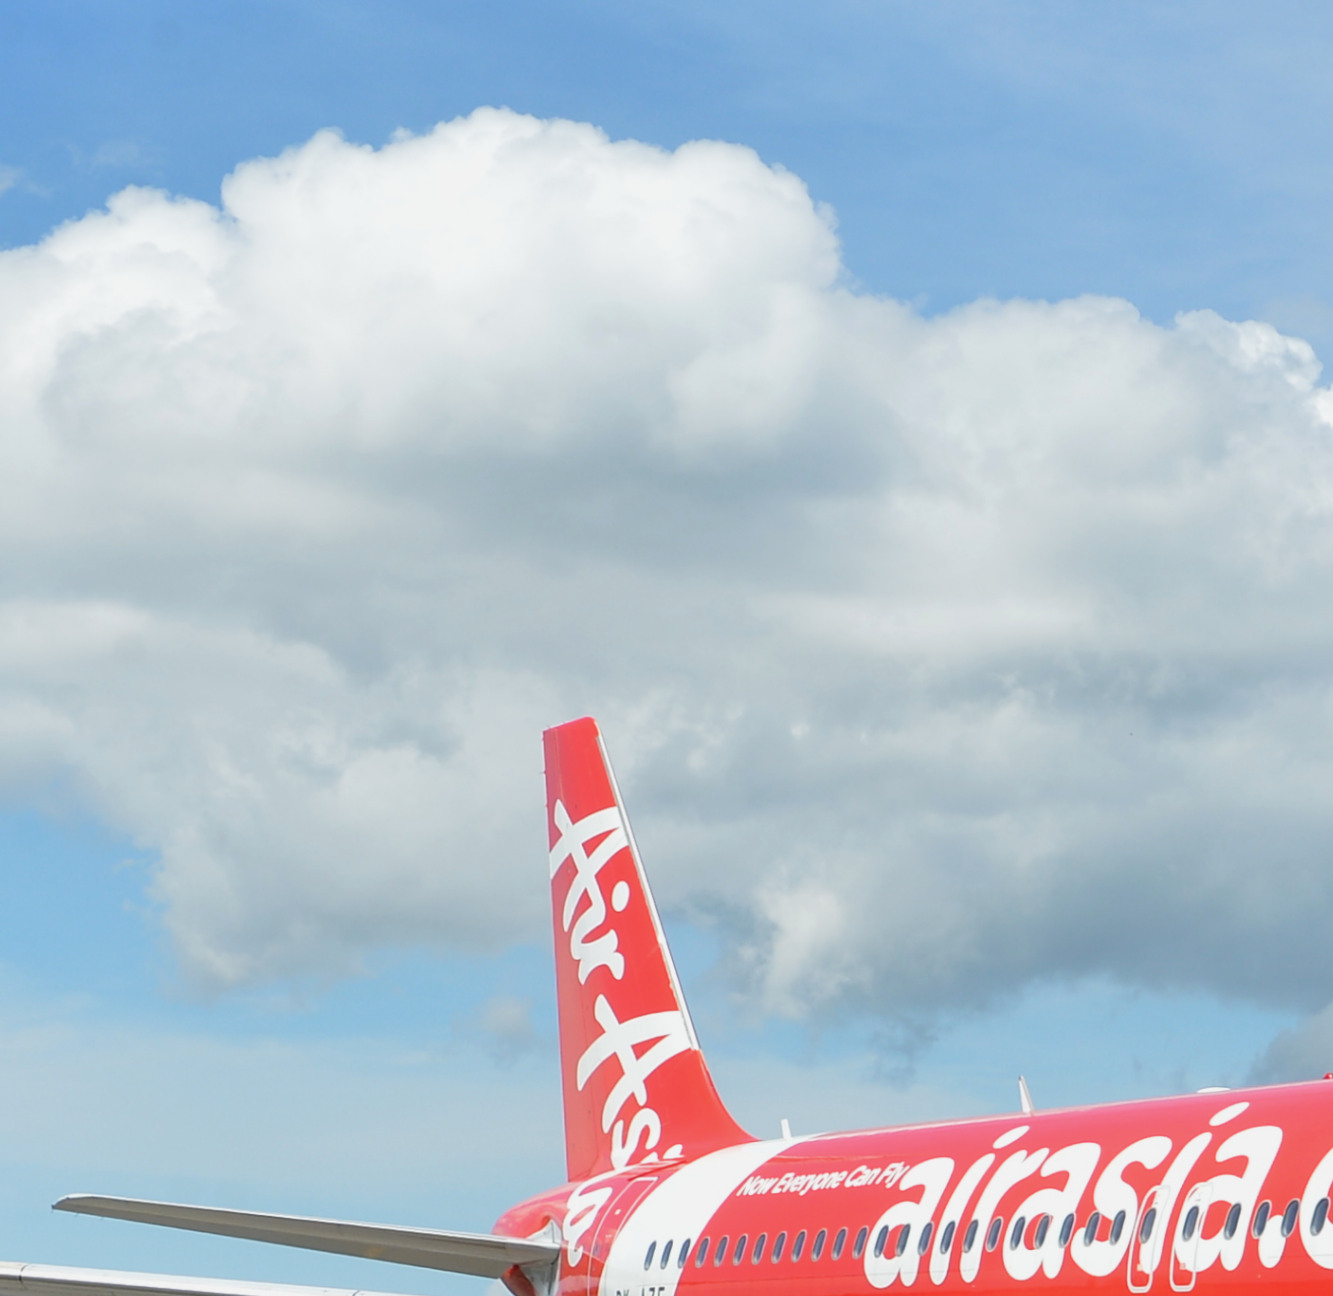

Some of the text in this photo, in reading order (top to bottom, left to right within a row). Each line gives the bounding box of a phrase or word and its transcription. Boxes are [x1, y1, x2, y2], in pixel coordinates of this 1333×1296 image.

[550, 798, 629, 985] Air
[735, 1161, 911, 1197] Now Everyone Can Fly
